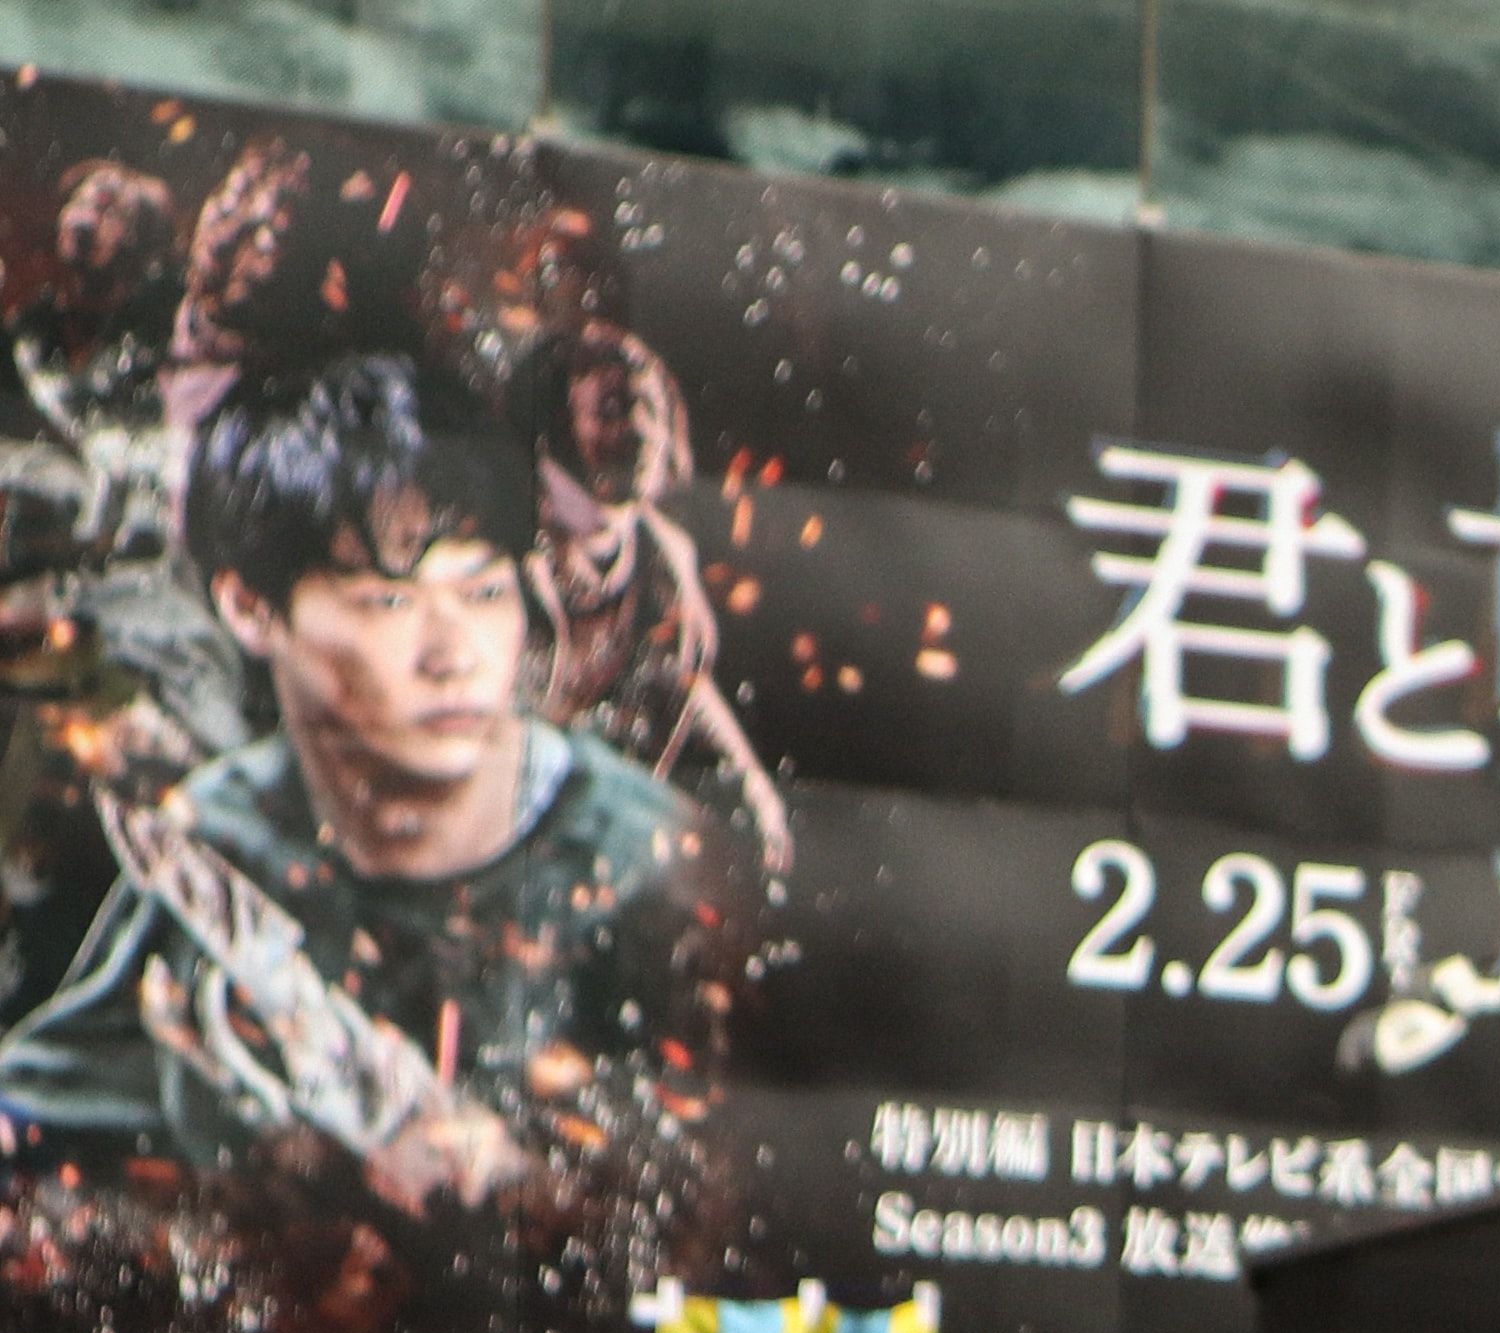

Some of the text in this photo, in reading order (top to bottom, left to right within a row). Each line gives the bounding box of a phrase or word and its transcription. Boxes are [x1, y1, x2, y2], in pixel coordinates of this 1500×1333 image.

[1066, 838, 1372, 1010] 2.25
[872, 1190, 1312, 1282] Season3 放送
